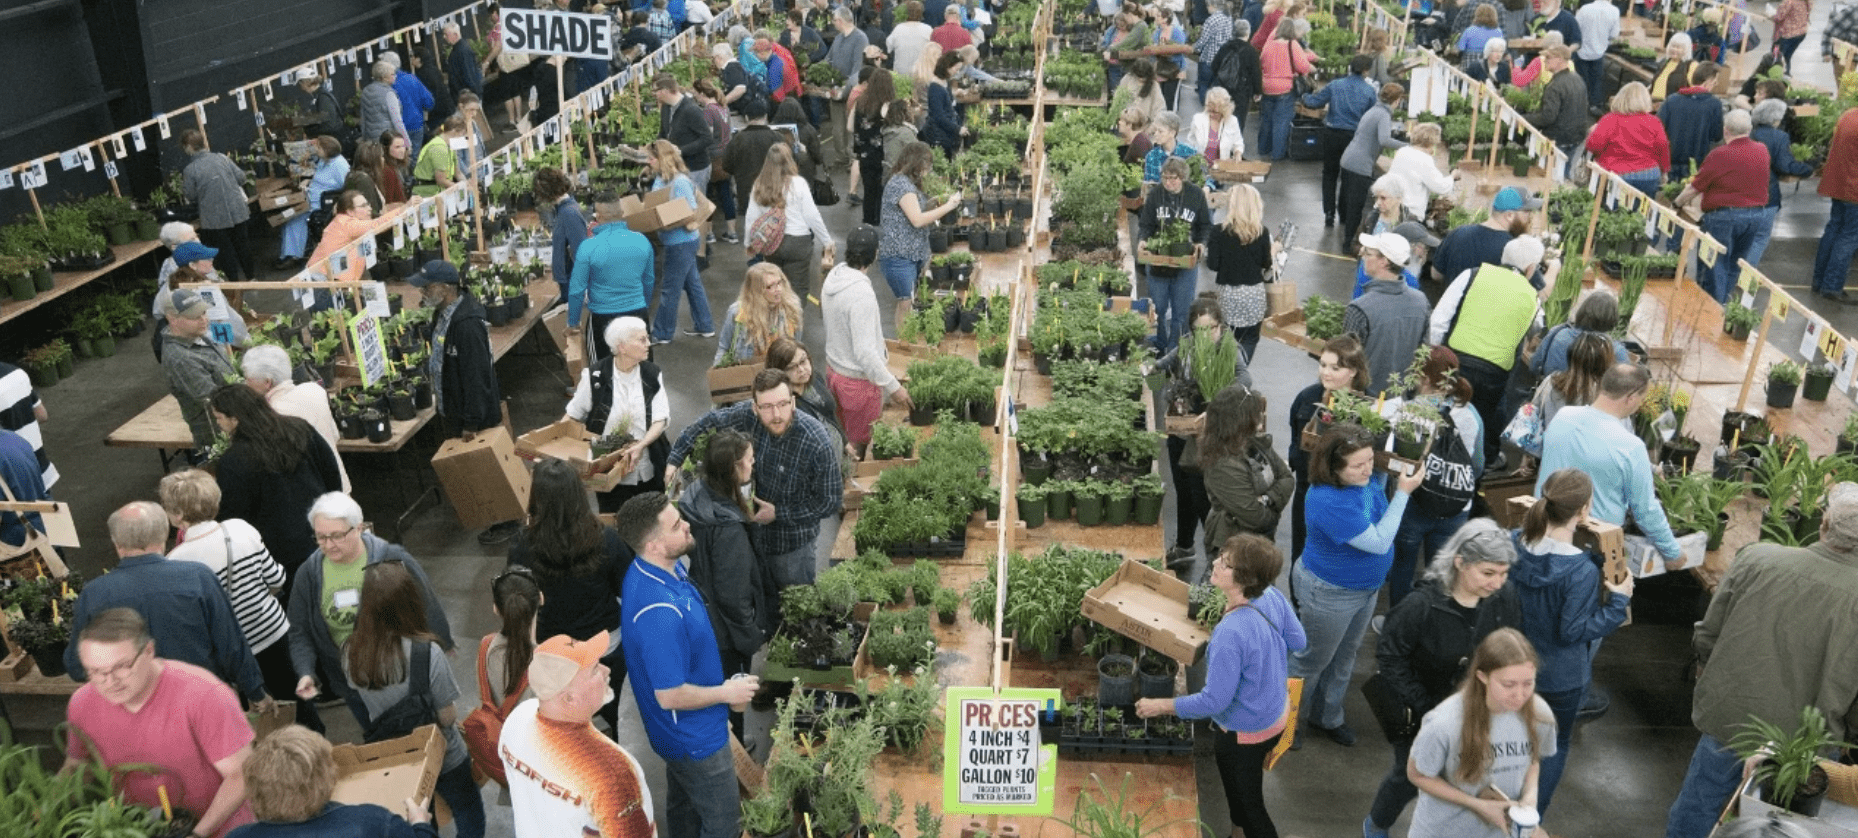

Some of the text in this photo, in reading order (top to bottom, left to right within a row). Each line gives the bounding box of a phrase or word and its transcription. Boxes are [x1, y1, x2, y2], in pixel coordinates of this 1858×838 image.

[504, 12, 609, 55] SHADE
[213, 325, 230, 342] H
[1825, 331, 1839, 358] H
[965, 702, 1037, 729] PRCES
[968, 730, 1030, 747] 4 INCH $4
[969, 748, 1030, 766] QUART $7
[1505, 741, 1536, 757] ISLAN
[501, 744, 582, 806] REDFISH
[961, 768, 1035, 785] GALLON $10
